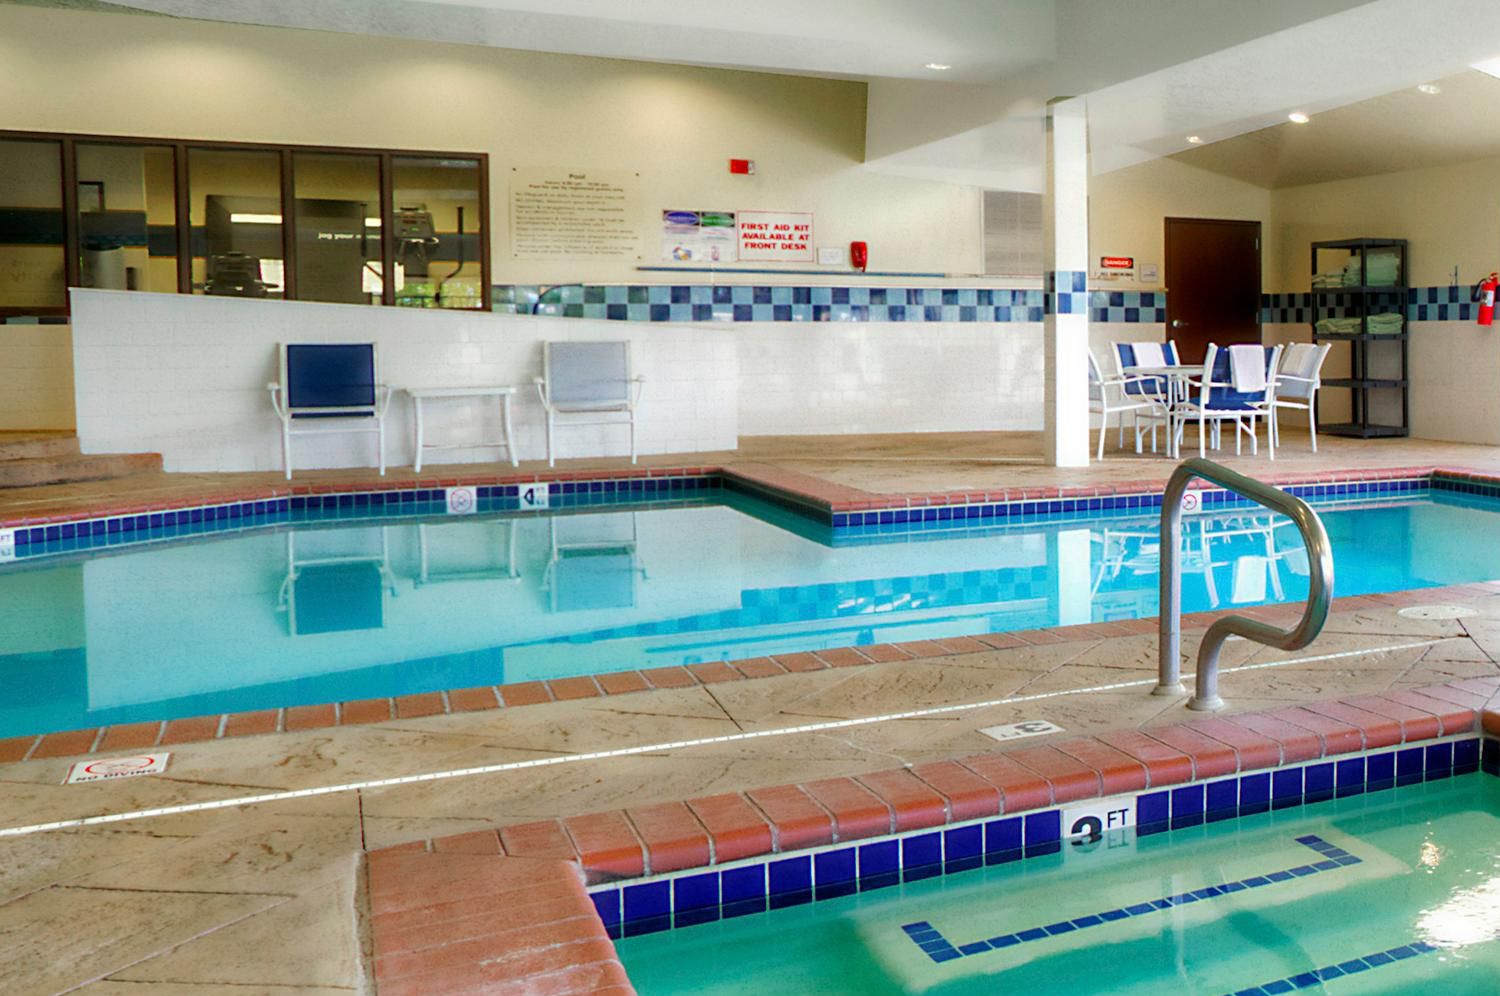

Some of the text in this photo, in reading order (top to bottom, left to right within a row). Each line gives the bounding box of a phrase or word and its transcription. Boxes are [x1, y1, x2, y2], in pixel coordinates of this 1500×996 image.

[741, 223, 809, 232] FIRST AID KIT
[742, 233, 793, 241] AVAILABLE
[744, 242, 807, 251] FRONT DESK
[1106, 808, 1129, 829] FT
